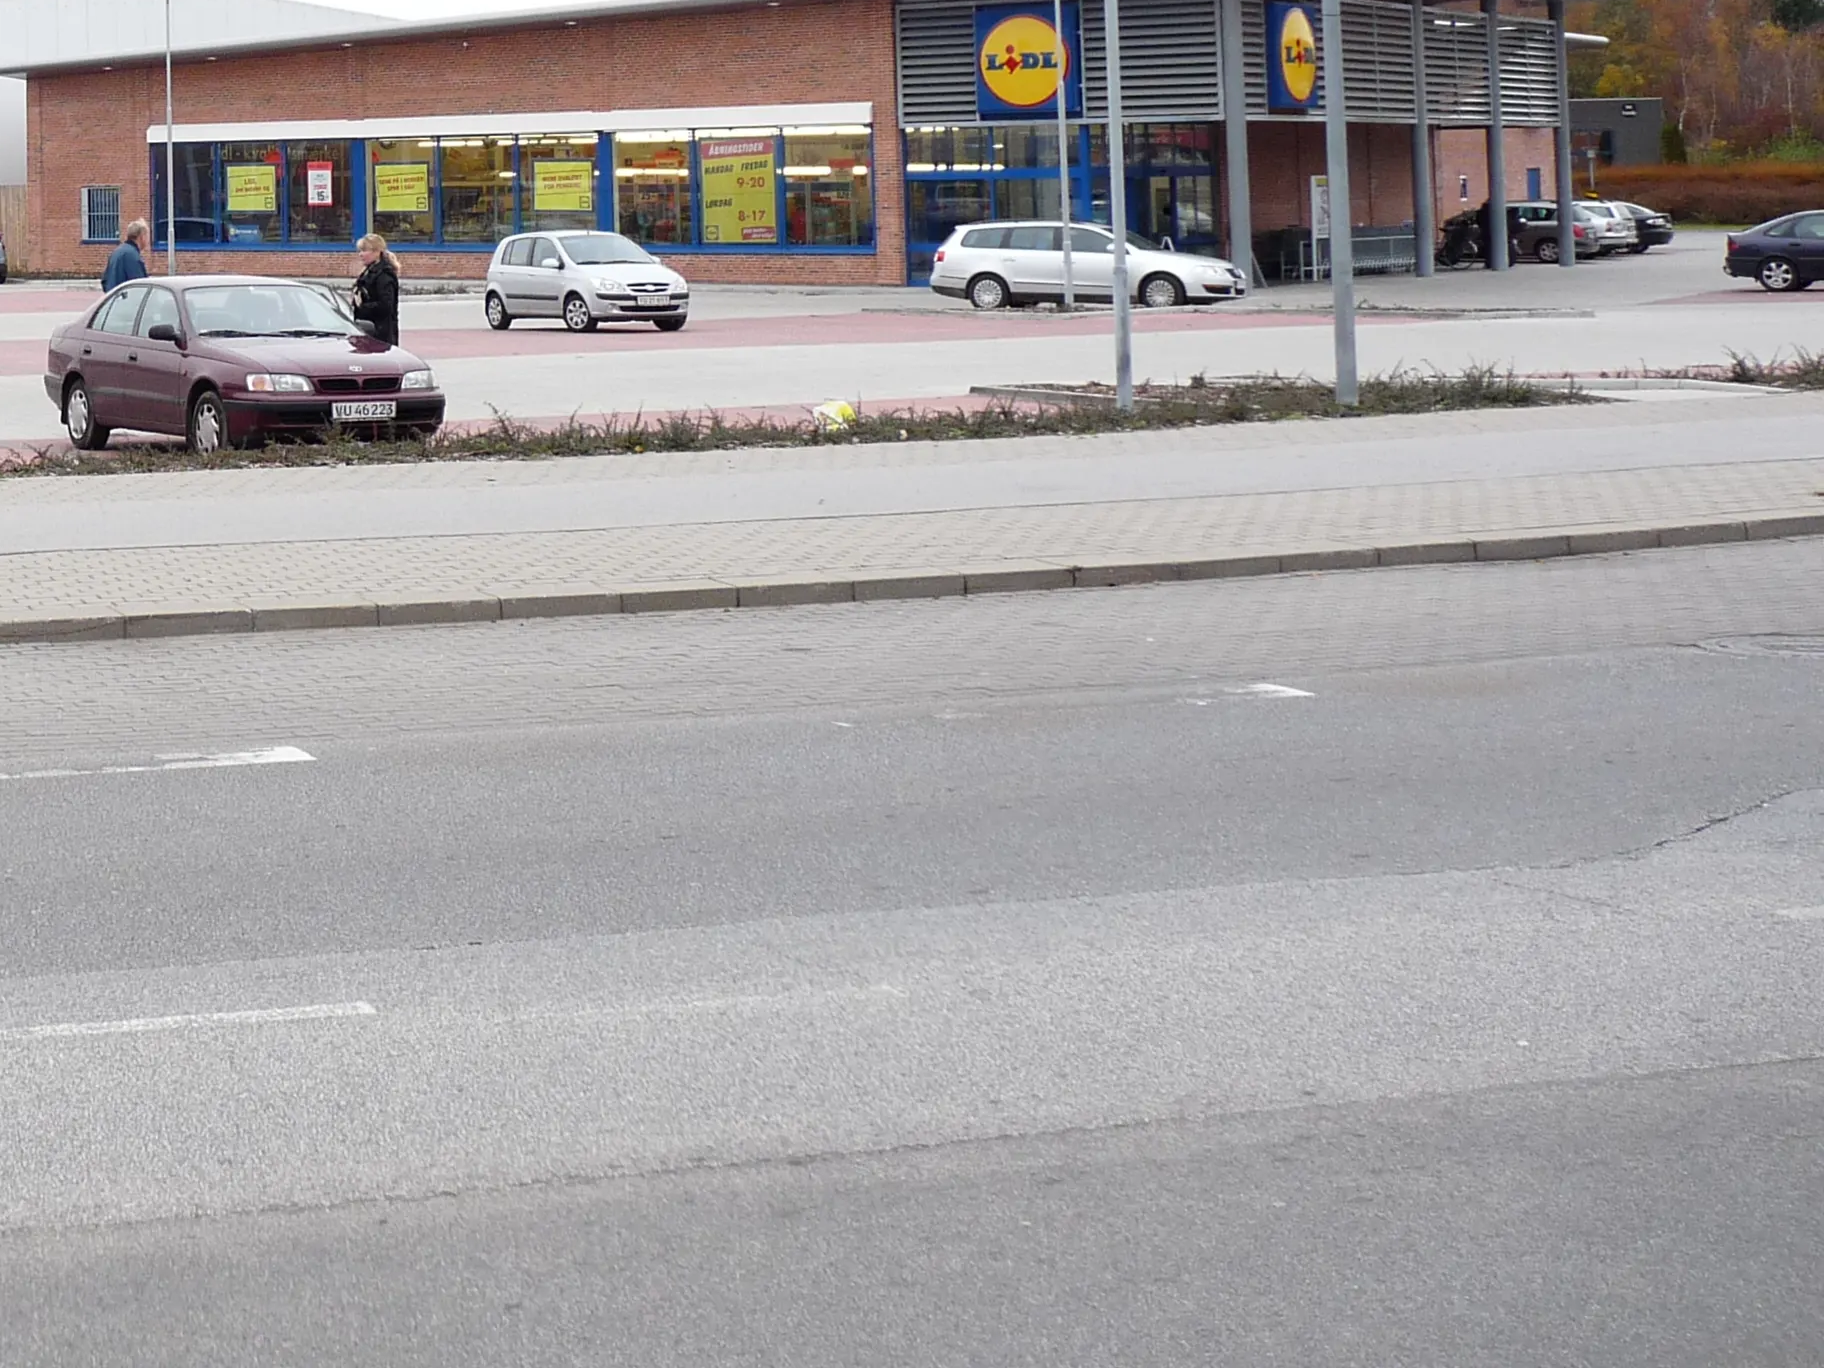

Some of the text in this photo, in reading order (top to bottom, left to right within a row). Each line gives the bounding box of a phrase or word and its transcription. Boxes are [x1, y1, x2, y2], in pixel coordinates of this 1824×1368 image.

[736, 176, 765, 188] 9-20
[738, 210, 766, 222] 8-17
[335, 404, 352, 417] VU
